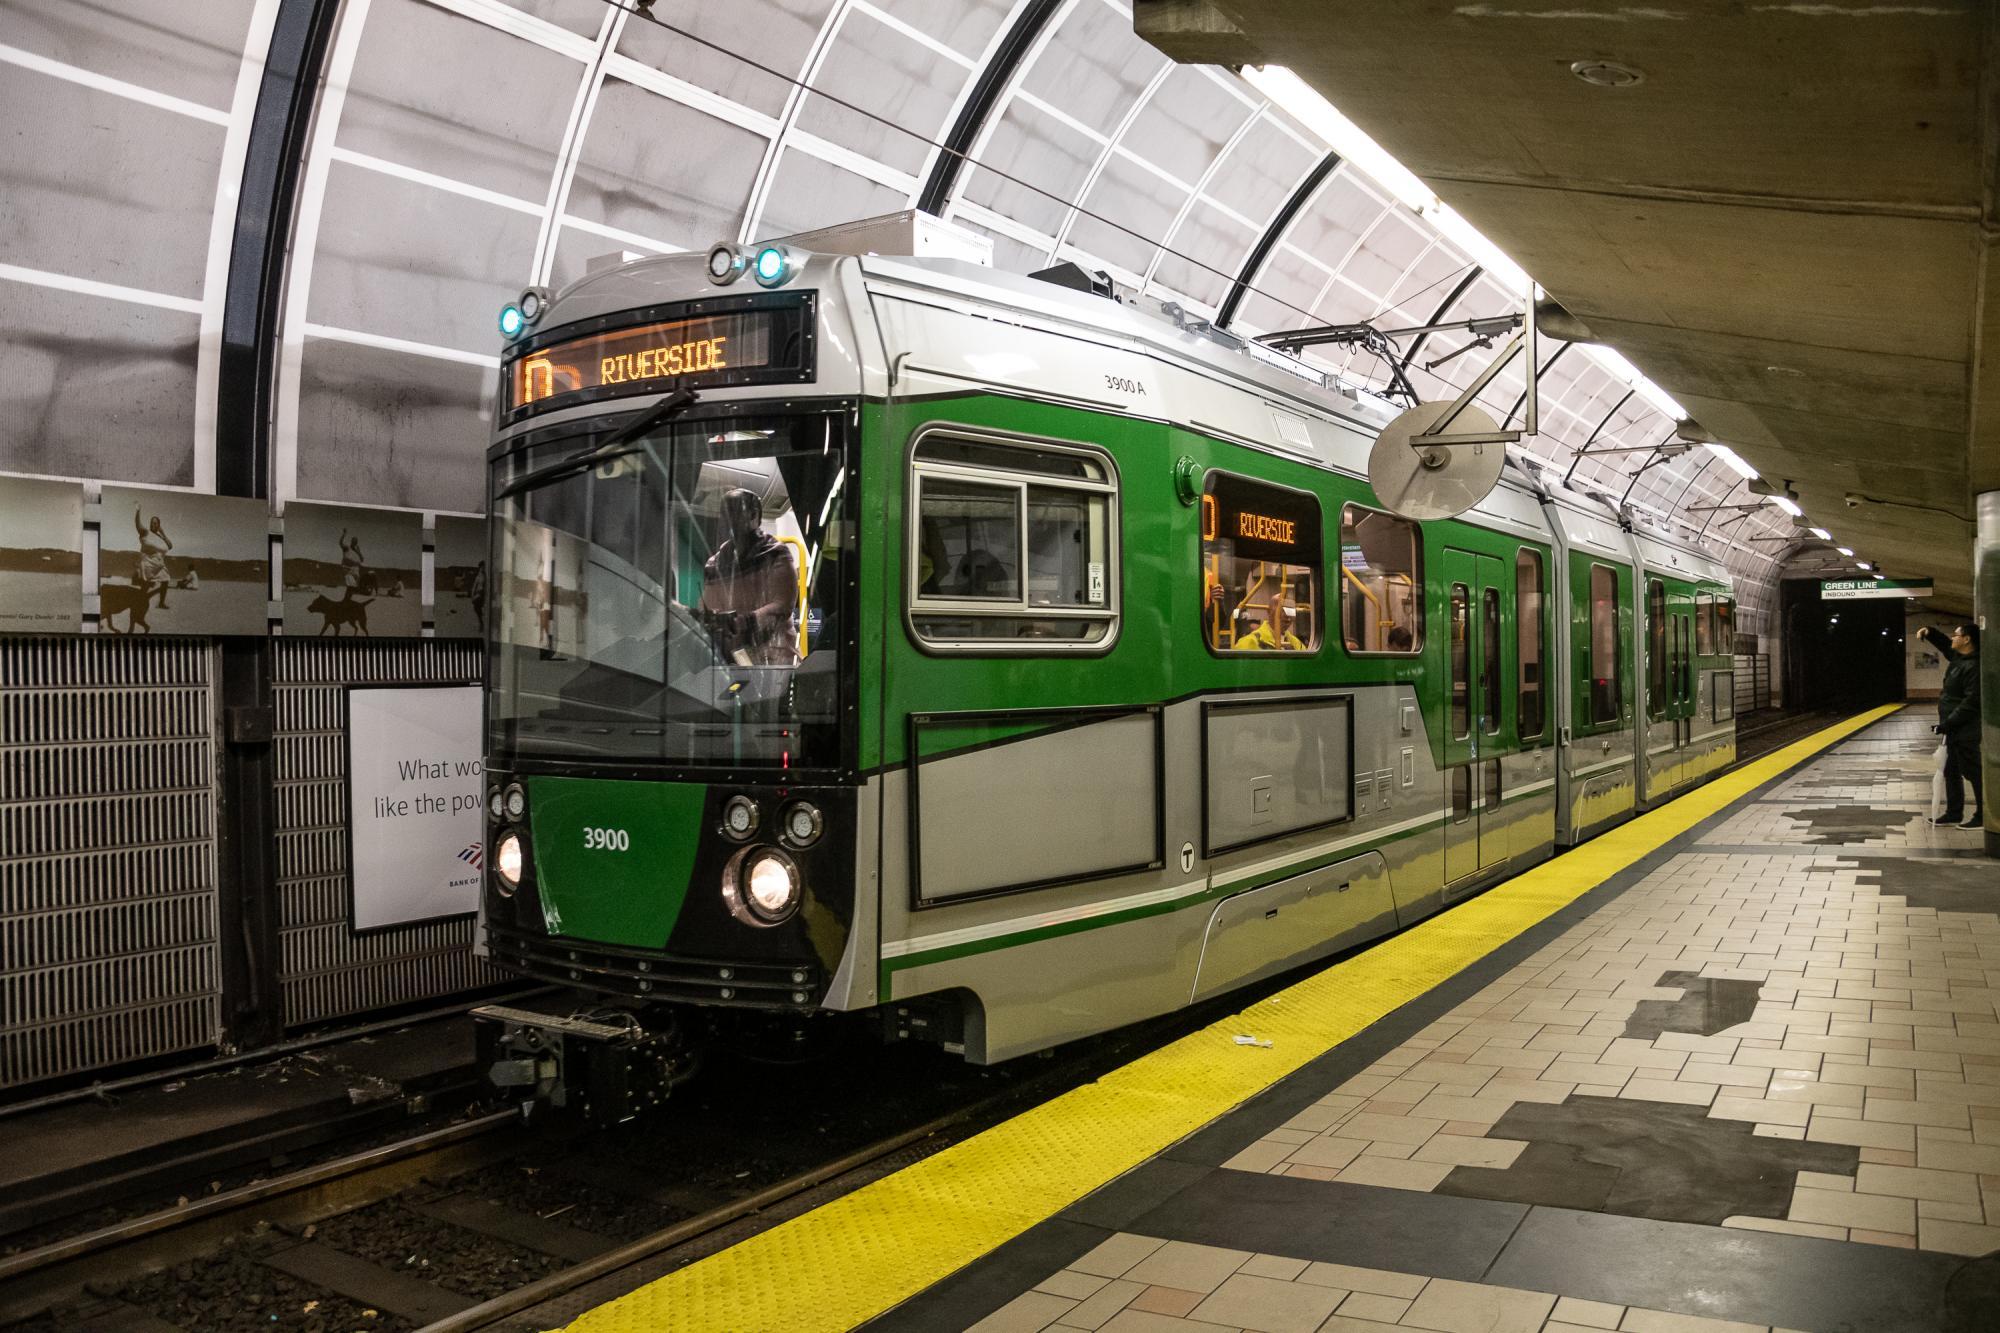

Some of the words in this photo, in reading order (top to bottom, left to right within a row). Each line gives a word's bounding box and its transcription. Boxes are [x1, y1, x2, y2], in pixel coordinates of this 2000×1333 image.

[601, 336, 726, 386] RIVERSIDE
[1104, 375, 1135, 393] 3900
[1137, 381, 1147, 396] A
[1240, 511, 1295, 544] RIVERSIDE
[1824, 581, 1855, 590] GREEN
[1857, 581, 1878, 589] LINE
[398, 759, 450, 781] What
[375, 796, 408, 818] like
[415, 793, 446, 814] the
[583, 827, 630, 851] 3900
[1183, 849, 1193, 869] T
[449, 880, 469, 888] BANK
